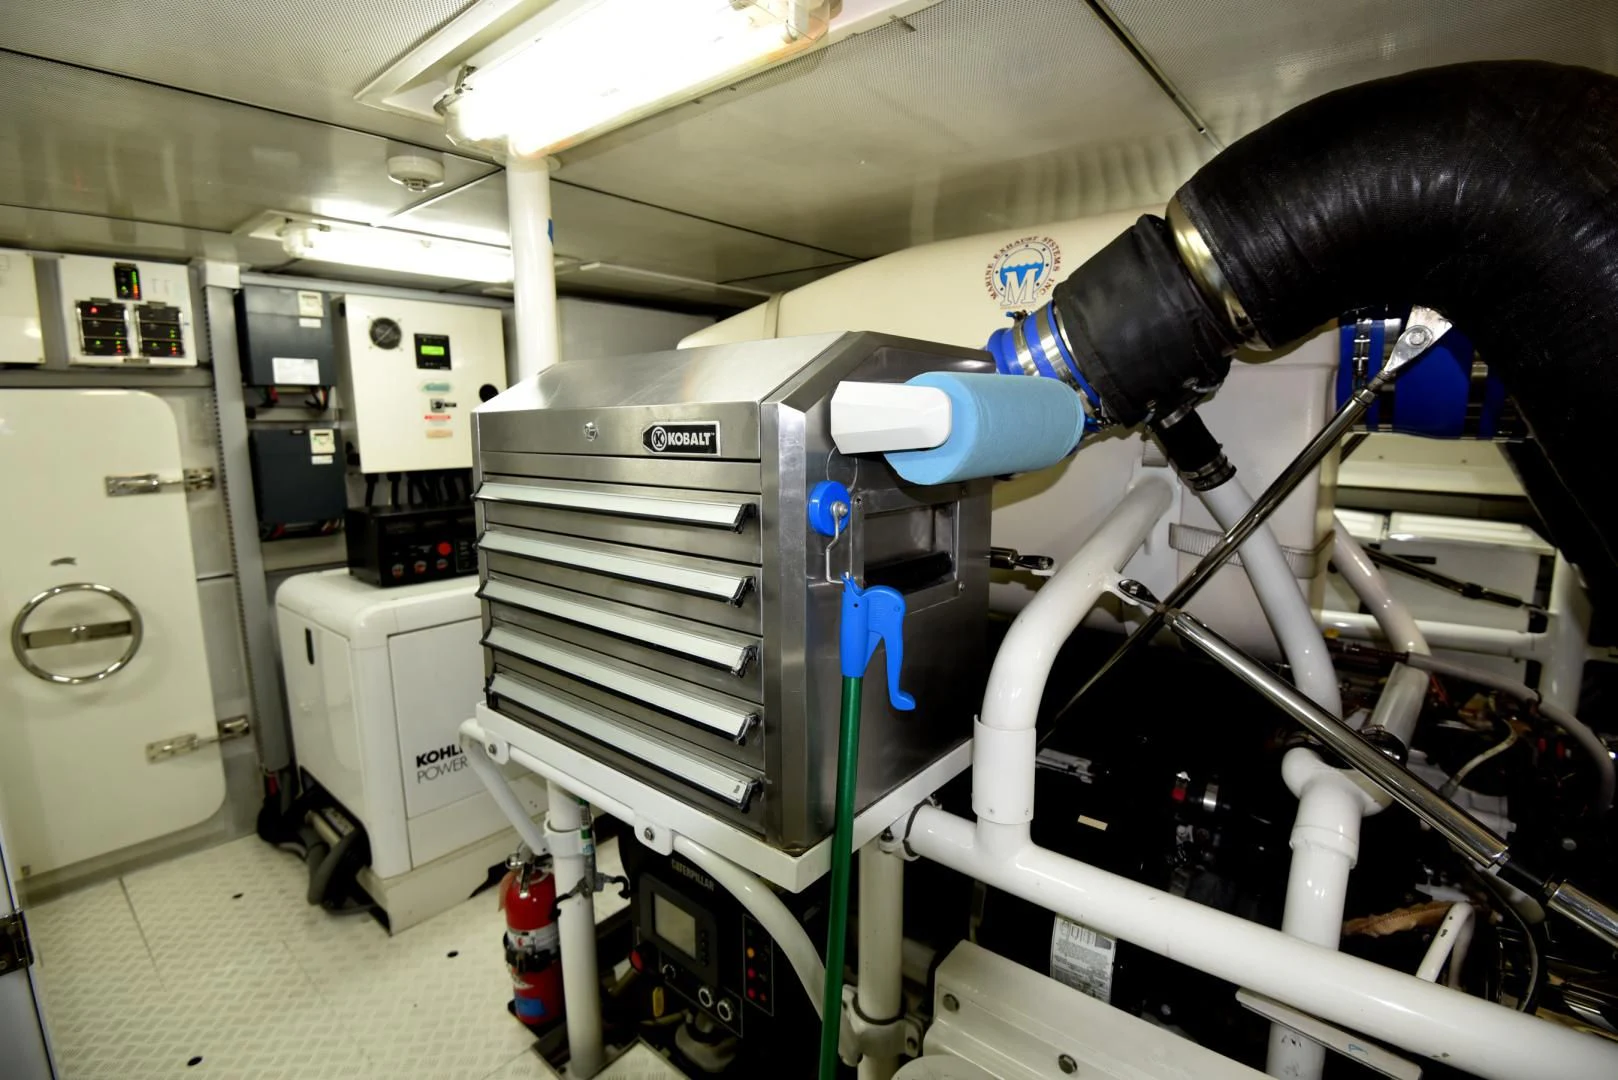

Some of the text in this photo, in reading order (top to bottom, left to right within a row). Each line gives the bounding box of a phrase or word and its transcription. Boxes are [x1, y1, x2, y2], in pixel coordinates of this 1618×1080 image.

[985, 236, 1061, 300] MARINE EXHAUST SYSTEMS INC
[1000, 268, 1036, 306] M
[668, 432, 711, 446] KOBALT
[416, 744, 464, 768] KOHL
[417, 755, 468, 784] POWER
[671, 860, 715, 892] CATERPILLAR
